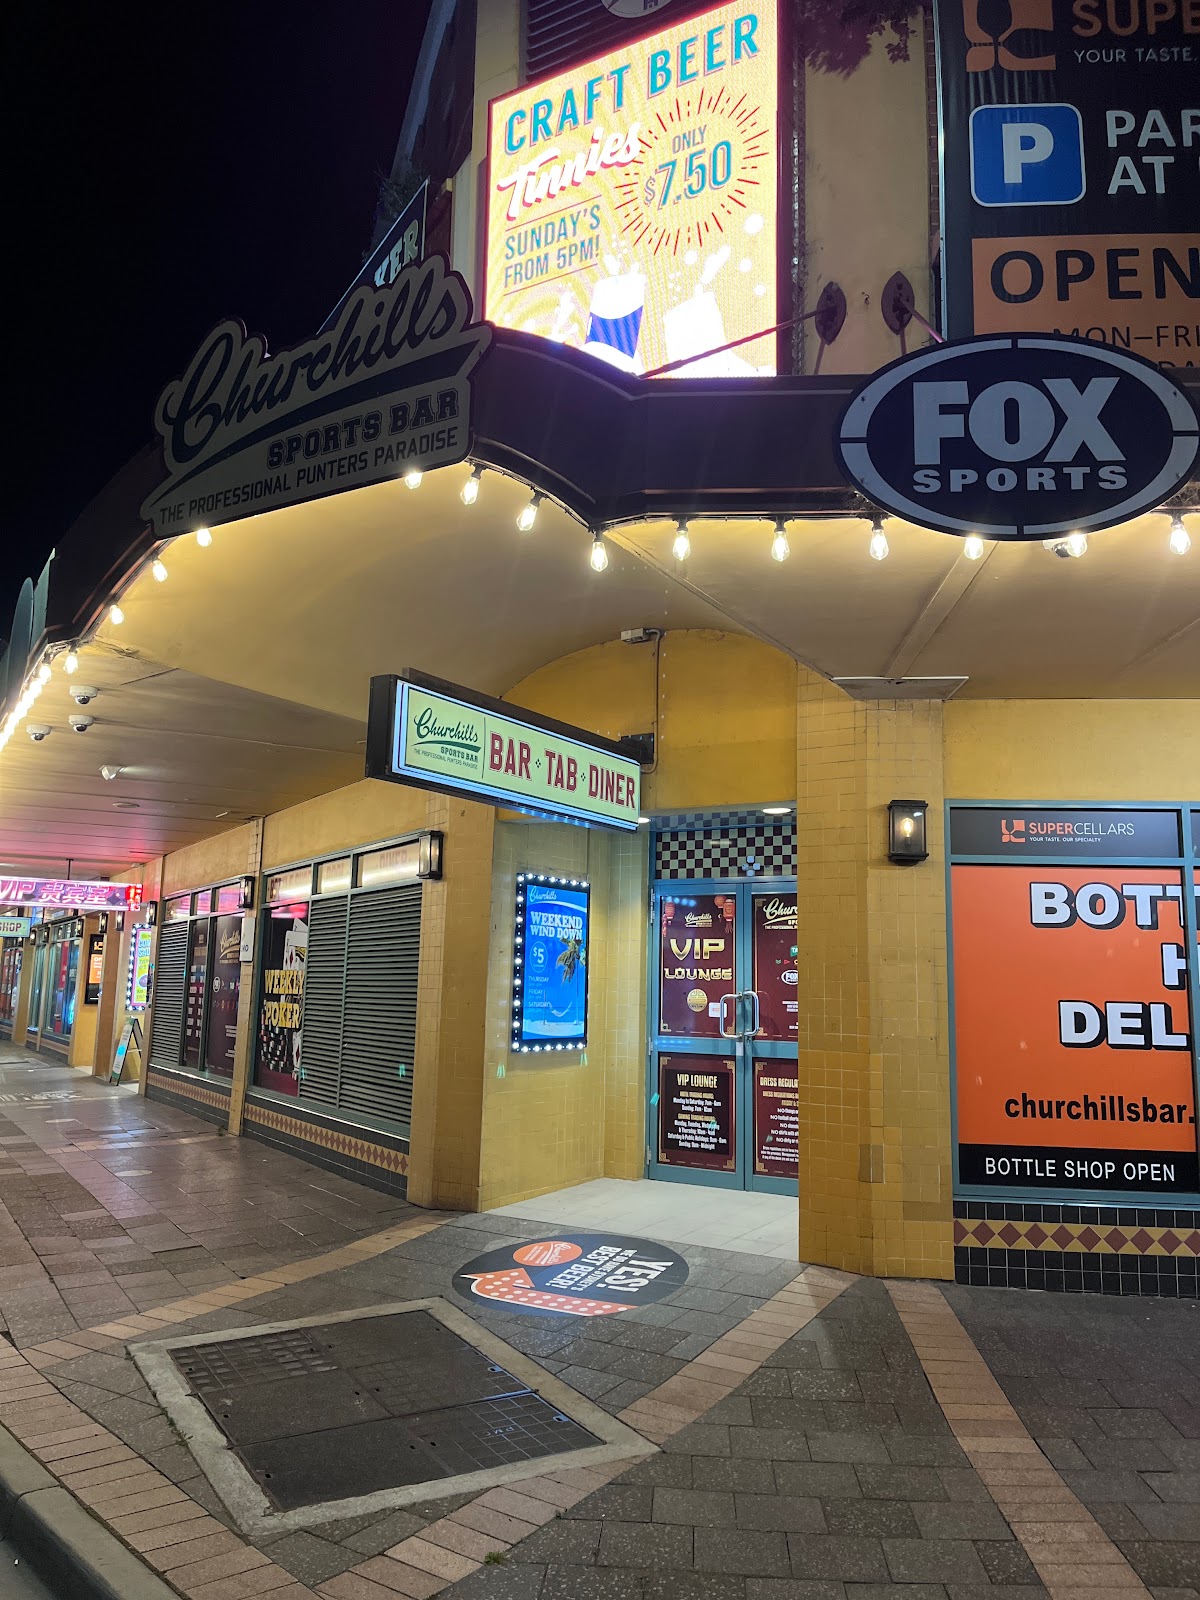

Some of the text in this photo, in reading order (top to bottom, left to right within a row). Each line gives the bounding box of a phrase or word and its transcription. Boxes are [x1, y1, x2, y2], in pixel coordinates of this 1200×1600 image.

[1073, 48, 1126, 63] YOUR
[505, 13, 760, 156] CRAFT BEER
[671, 125, 708, 155] ONLY
[1002, 122, 1054, 184] P
[497, 122, 641, 221] Tinnies
[643, 140, 732, 211] $7.50
[1107, 155, 1175, 195] AT
[505, 204, 602, 260] SUNDAY'S
[504, 235, 601, 289] FROM 5PM!
[990, 247, 1200, 304] OPEN
[161, 267, 458, 465] Churchills
[266, 388, 460, 470] SPORTS BAR
[912, 376, 1127, 466] FOX
[159, 426, 459, 526] THE PROFESSIONAL PUNTERS PARADISE
[912, 465, 1128, 494] SPORTS
[413, 707, 479, 743] Churchills
[440, 746, 479, 763] SPORTS BAR
[489, 730, 636, 811] BAR TAB DINER
[1028, 822, 1135, 836] SUPERCELLARS
[39, 883, 110, 905] 贵宾室
[528, 885, 558, 903] Churchills
[530, 910, 583, 930] WEEKEND
[530, 924, 583, 940] WIND DOWN
[533, 946, 545, 964] $5
[669, 938, 726, 960] VIP
[264, 969, 305, 995] WEEKLY
[664, 966, 733, 981] LOUNGE
[264, 1001, 300, 1029] POKER
[676, 1073, 718, 1089] VIP LOUNGE
[985, 1157, 1176, 1182] BOTTLE SHOP OPEN
[544, 1245, 623, 1290] BEST BEER!
[596, 1259, 674, 1293] YES!
